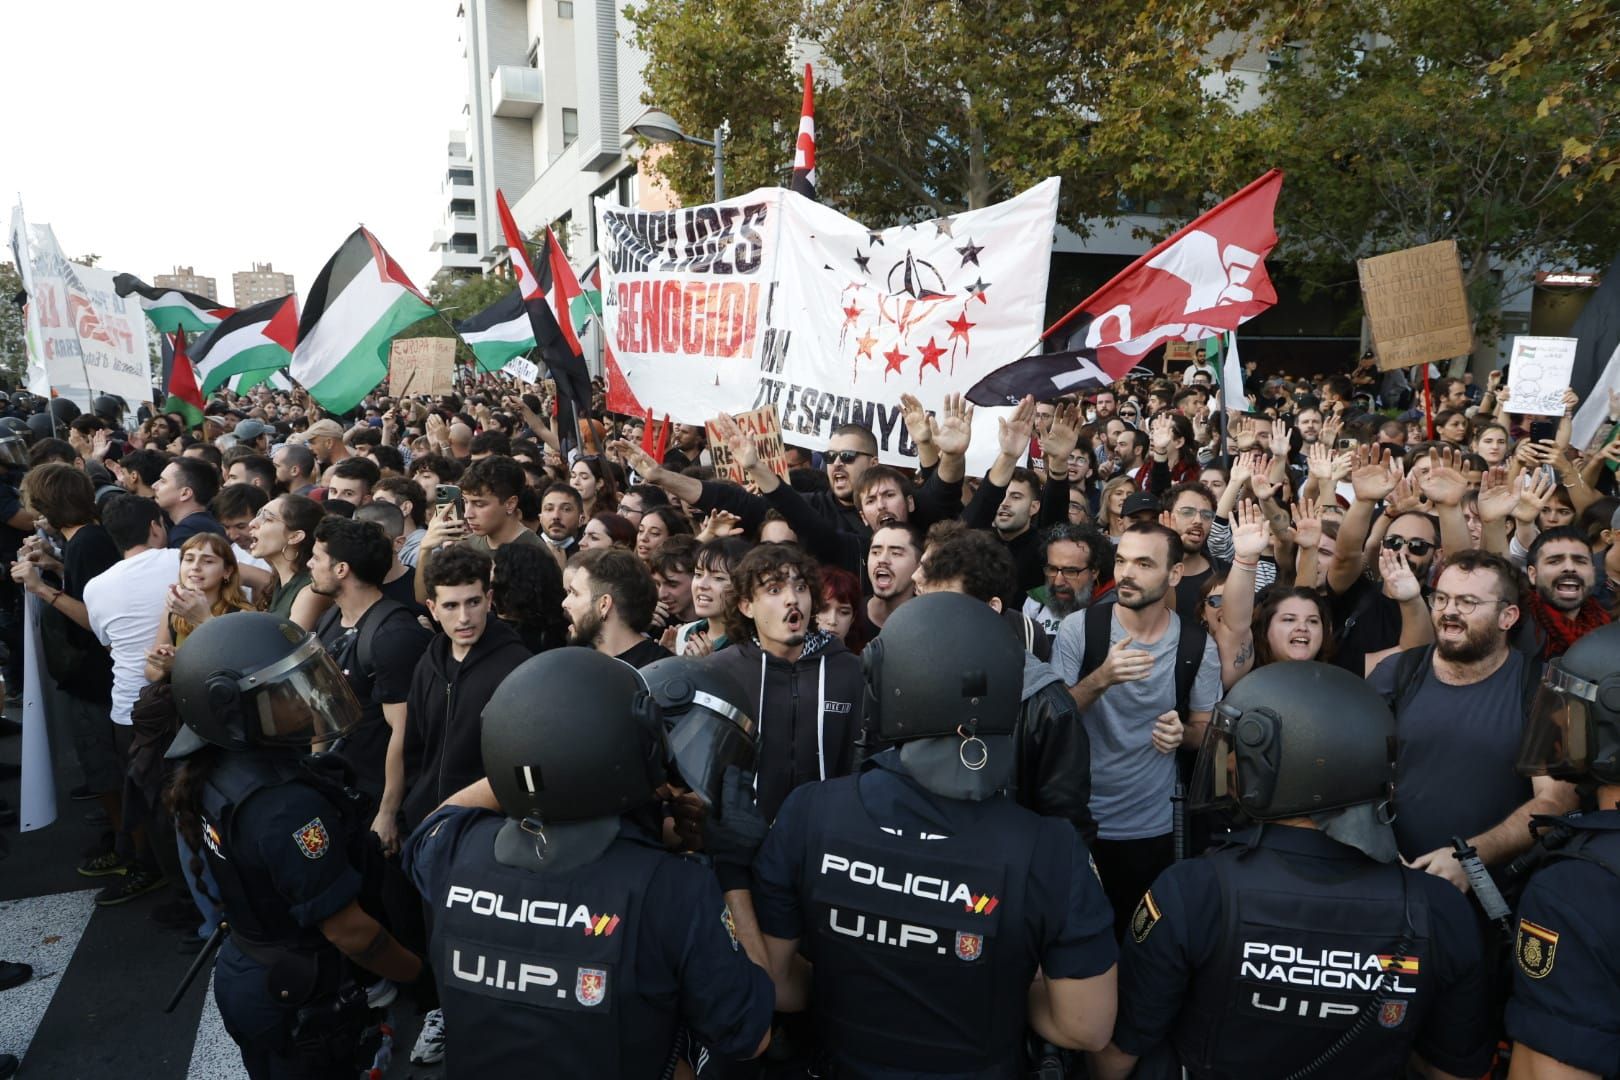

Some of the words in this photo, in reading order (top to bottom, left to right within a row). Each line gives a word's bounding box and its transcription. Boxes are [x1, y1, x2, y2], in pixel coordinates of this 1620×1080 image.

[821, 853, 974, 908] POLICIA
[446, 885, 592, 929] POLICIA
[829, 908, 947, 955] U.I.P.
[452, 950, 567, 999] U.I.P.
[1240, 961, 1417, 993] NACIONAL
[1243, 942, 1383, 971] POLICIA
